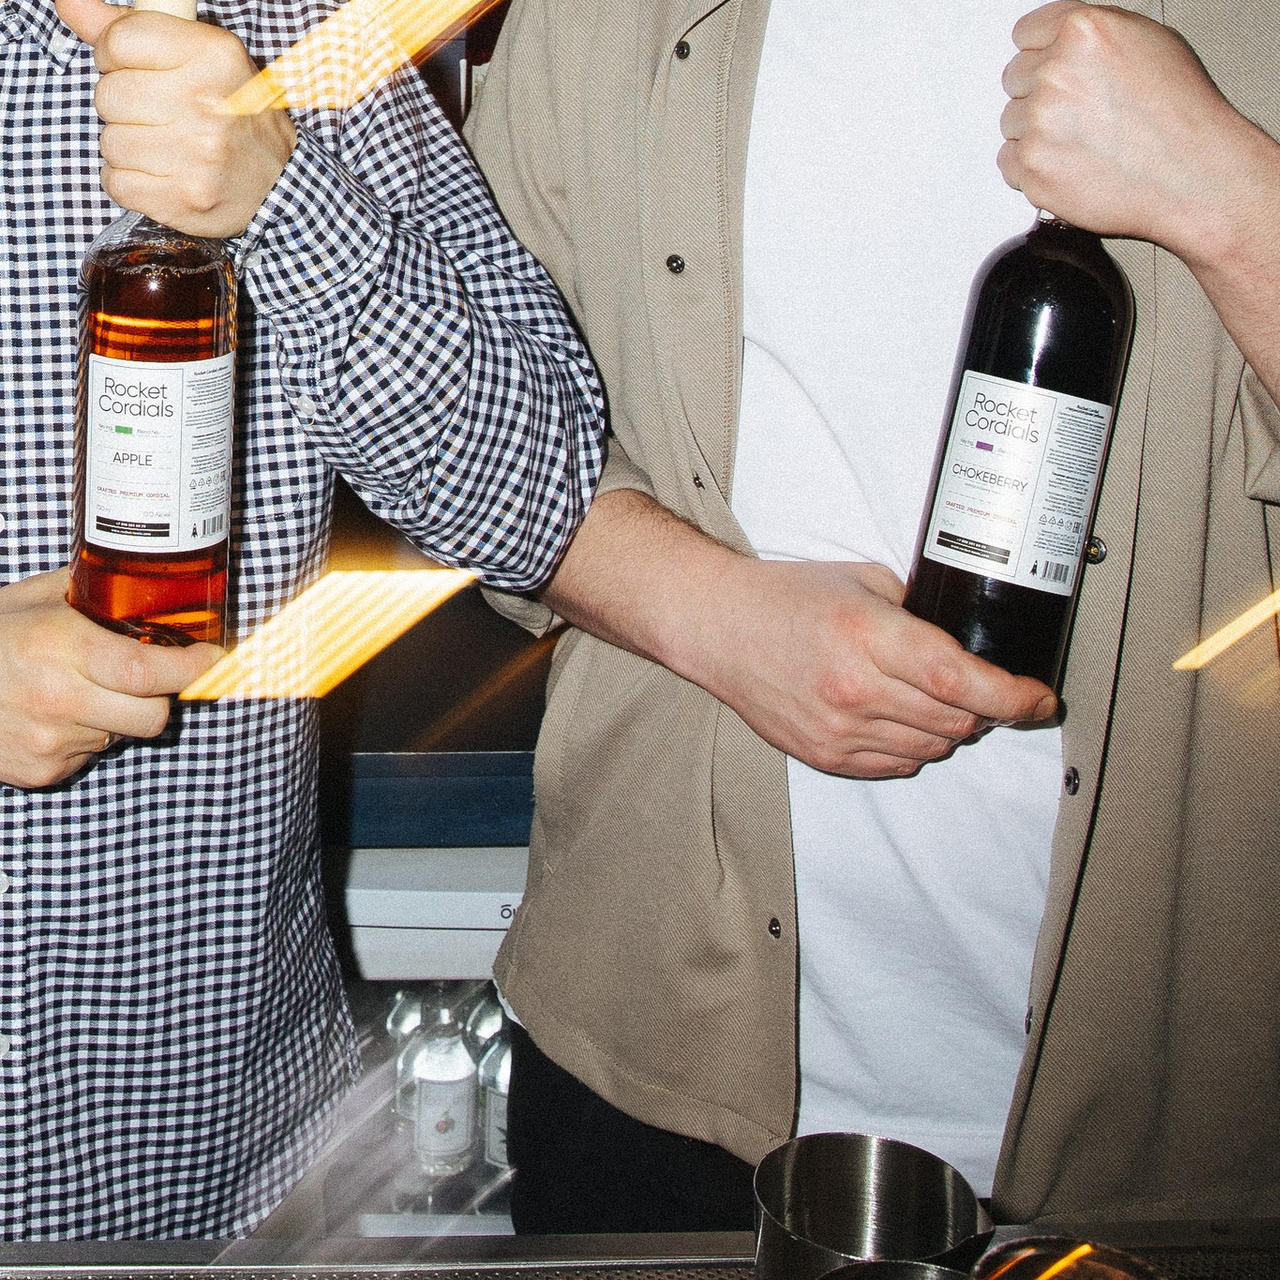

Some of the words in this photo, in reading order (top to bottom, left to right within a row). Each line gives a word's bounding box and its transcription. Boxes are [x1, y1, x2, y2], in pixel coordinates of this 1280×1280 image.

[104, 377, 168, 400] Rocket
[98, 394, 174, 418] Cordials
[973, 392, 1038, 424] Rocket
[964, 409, 1040, 444] Cordials
[112, 451, 153, 467] APPLE
[952, 463, 1029, 493] CHOKEBERRY
